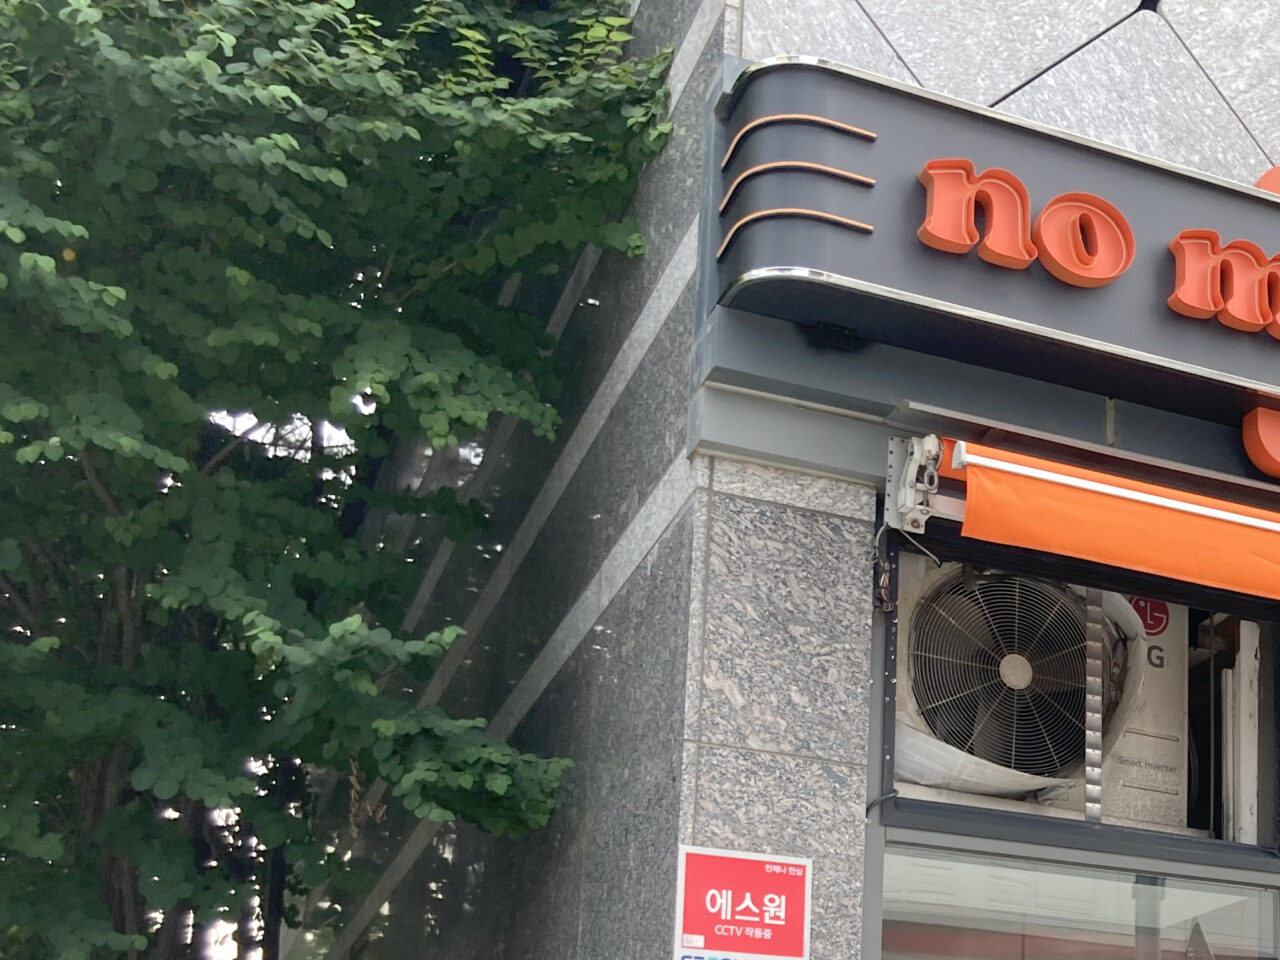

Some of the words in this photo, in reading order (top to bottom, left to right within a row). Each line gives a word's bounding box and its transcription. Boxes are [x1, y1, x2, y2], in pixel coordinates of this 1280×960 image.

[917, 158, 1136, 288] no
[1117, 755, 1143, 770] Smart
[1145, 758, 1178, 775] Inverter
[705, 888, 786, 925] 에스원
[714, 924, 743, 937] CCTV
[744, 926, 773, 940] 작동중
